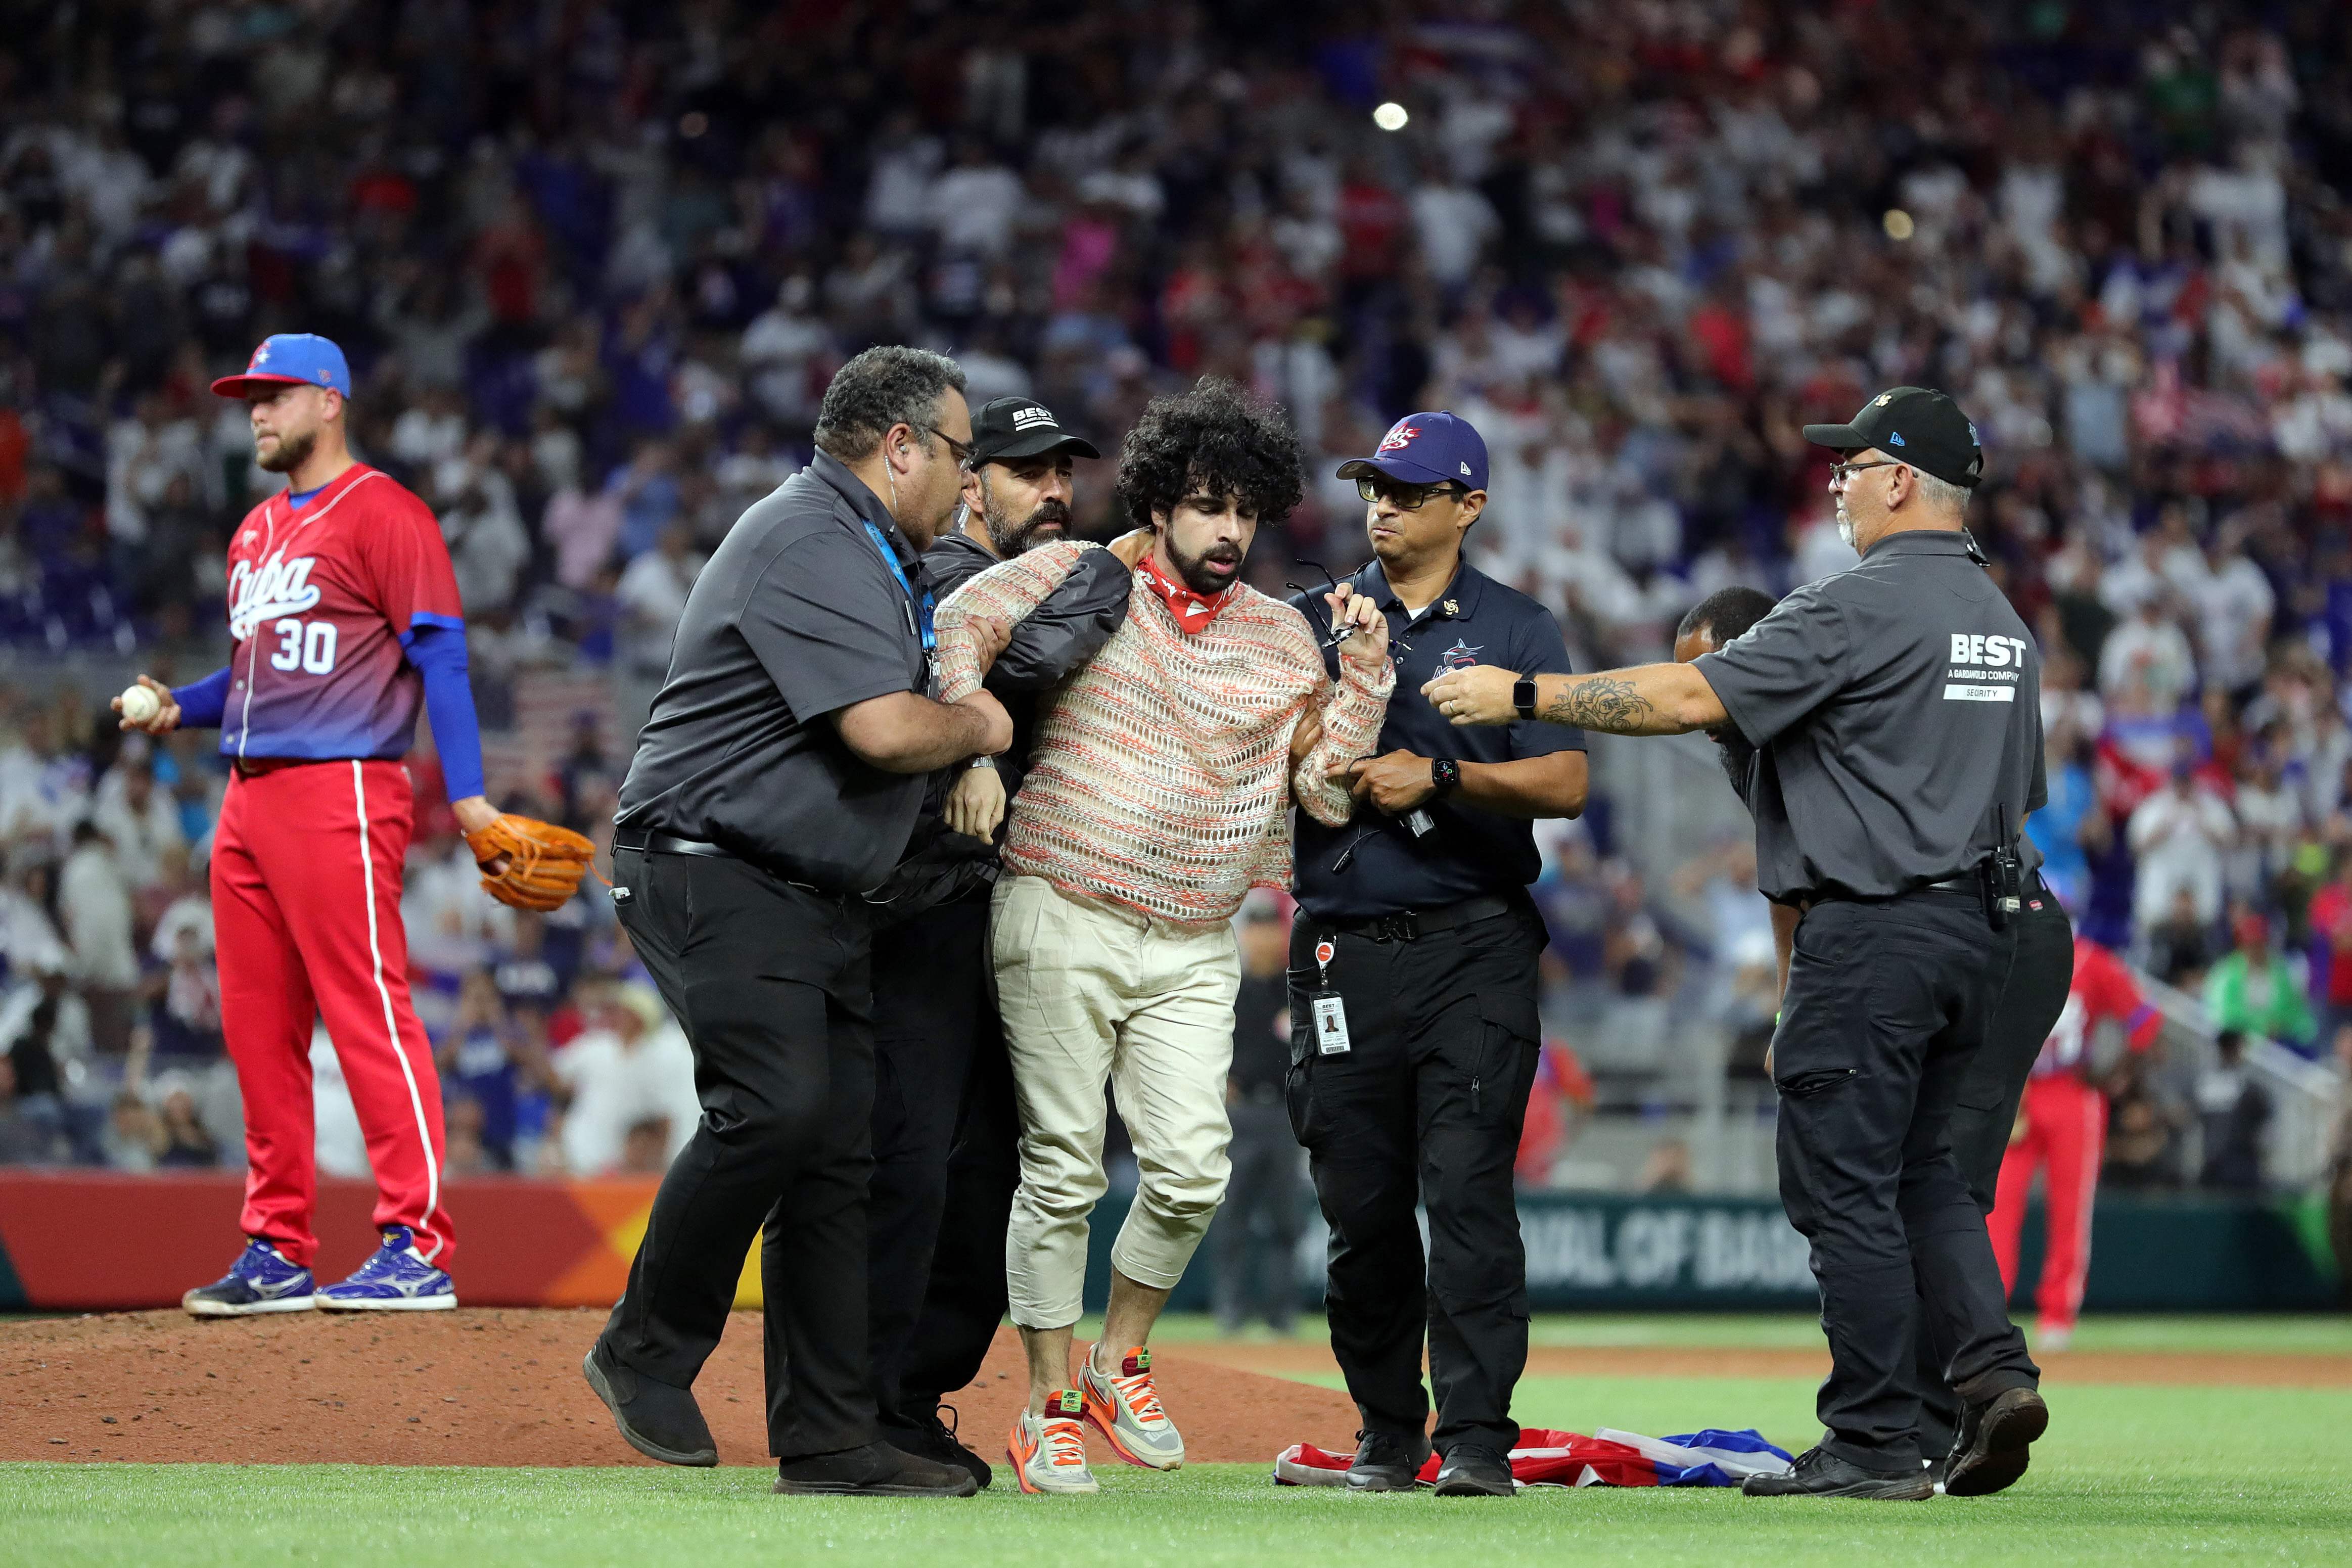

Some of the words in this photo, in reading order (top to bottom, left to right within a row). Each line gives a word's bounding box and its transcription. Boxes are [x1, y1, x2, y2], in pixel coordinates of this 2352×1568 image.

[1012, 407, 1053, 422] BEST
[229, 549, 320, 624] Cuba
[271, 618, 337, 675] 30
[1950, 633, 2026, 668] BEST
[1948, 669, 1953, 678] A
[1619, 1207, 1692, 1289] OF
